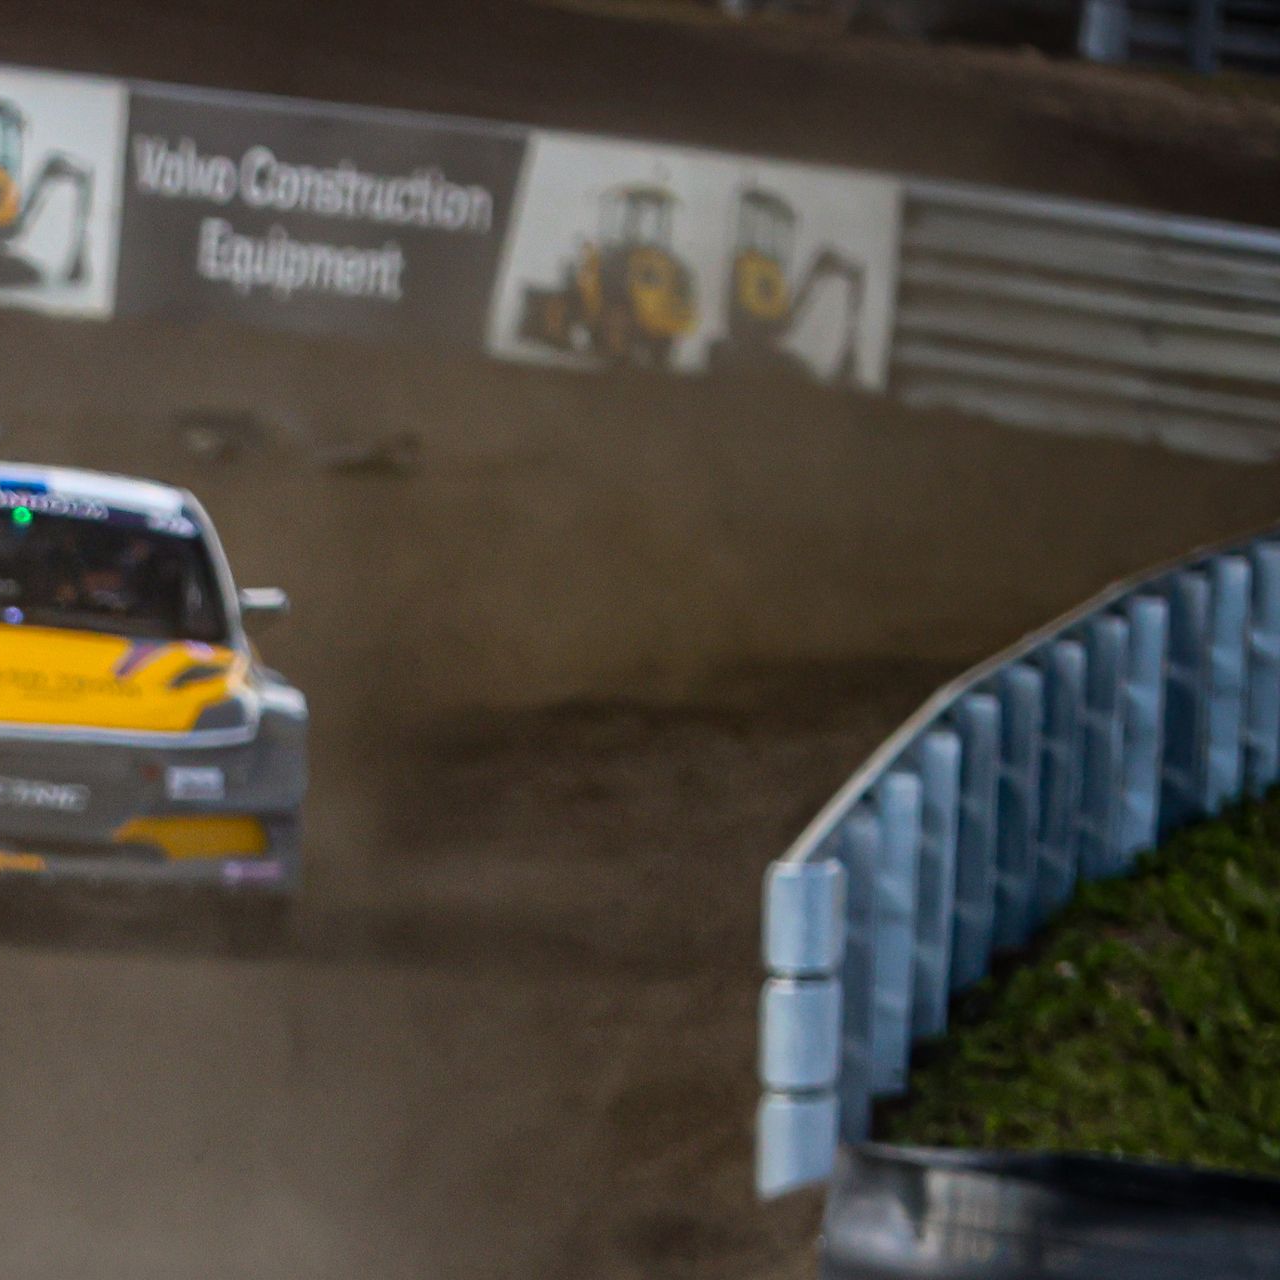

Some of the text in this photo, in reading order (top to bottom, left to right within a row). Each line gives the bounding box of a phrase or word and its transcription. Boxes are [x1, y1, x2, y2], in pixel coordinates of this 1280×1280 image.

[134, 133, 493, 235] Volvo Construction
[196, 216, 405, 302] Equipment
